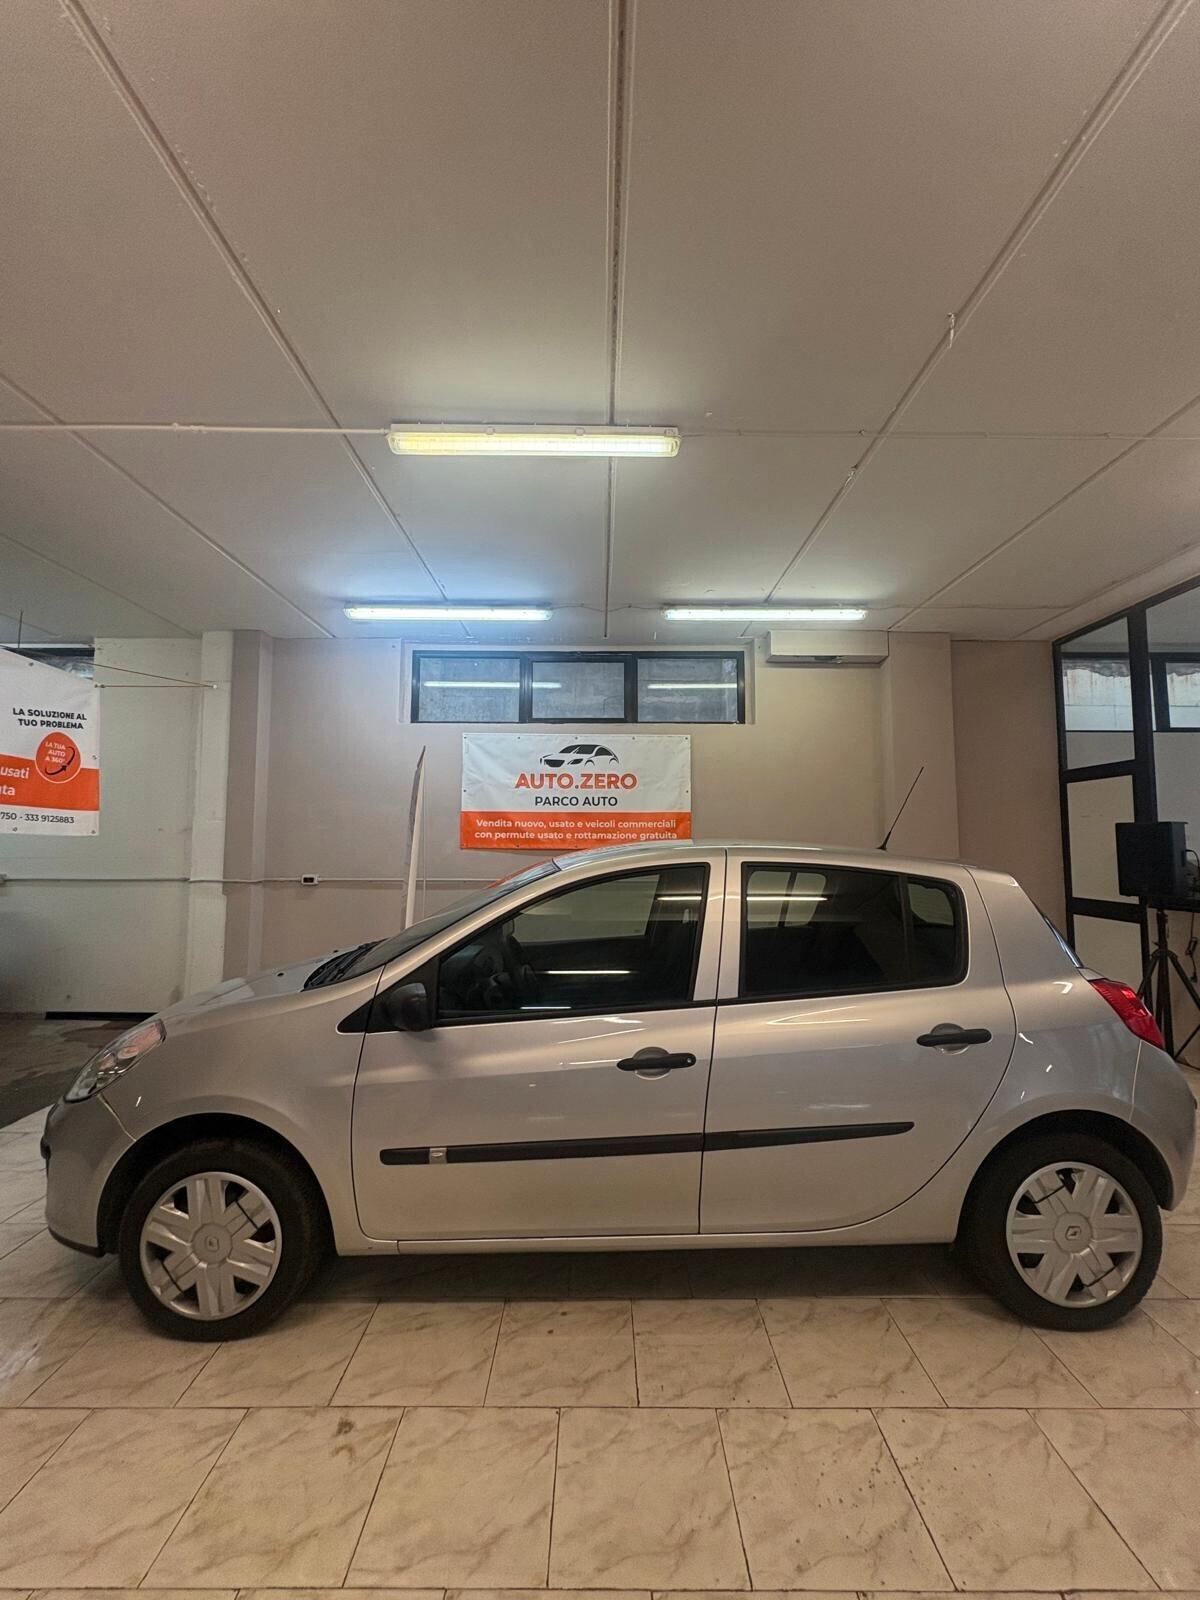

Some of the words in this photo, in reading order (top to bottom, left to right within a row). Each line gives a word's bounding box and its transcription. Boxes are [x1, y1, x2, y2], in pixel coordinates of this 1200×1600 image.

[12, 707, 25, 716] LA
[27, 708, 75, 720] SOLUZIONE
[76, 712, 87, 721] AL
[18, 718, 38, 727] TUO
[40, 719, 84, 729] PROBLEMA
[48, 749, 66, 757] AUTO
[0, 766, 30, 779] usati
[514, 773, 637, 789] AUTO.ZERO
[0, 785, 16, 796] ta
[534, 796, 579, 806] PARCO
[582, 796, 618, 806] AUTO
[24, 813, 39, 822] 333
[41, 814, 75, 824] 9125883
[476, 818, 512, 828] Vendita
[515, 820, 547, 829] nuovo,
[549, 819, 575, 828] usato
[585, 818, 616, 828] veicoli
[618, 818, 676, 828] commerciali
[474, 831, 493, 839] con
[494, 830, 535, 841] permute
[537, 830, 564, 839] usato
[574, 830, 637, 840] rottamazione
[640, 830, 677, 842] gratuita
